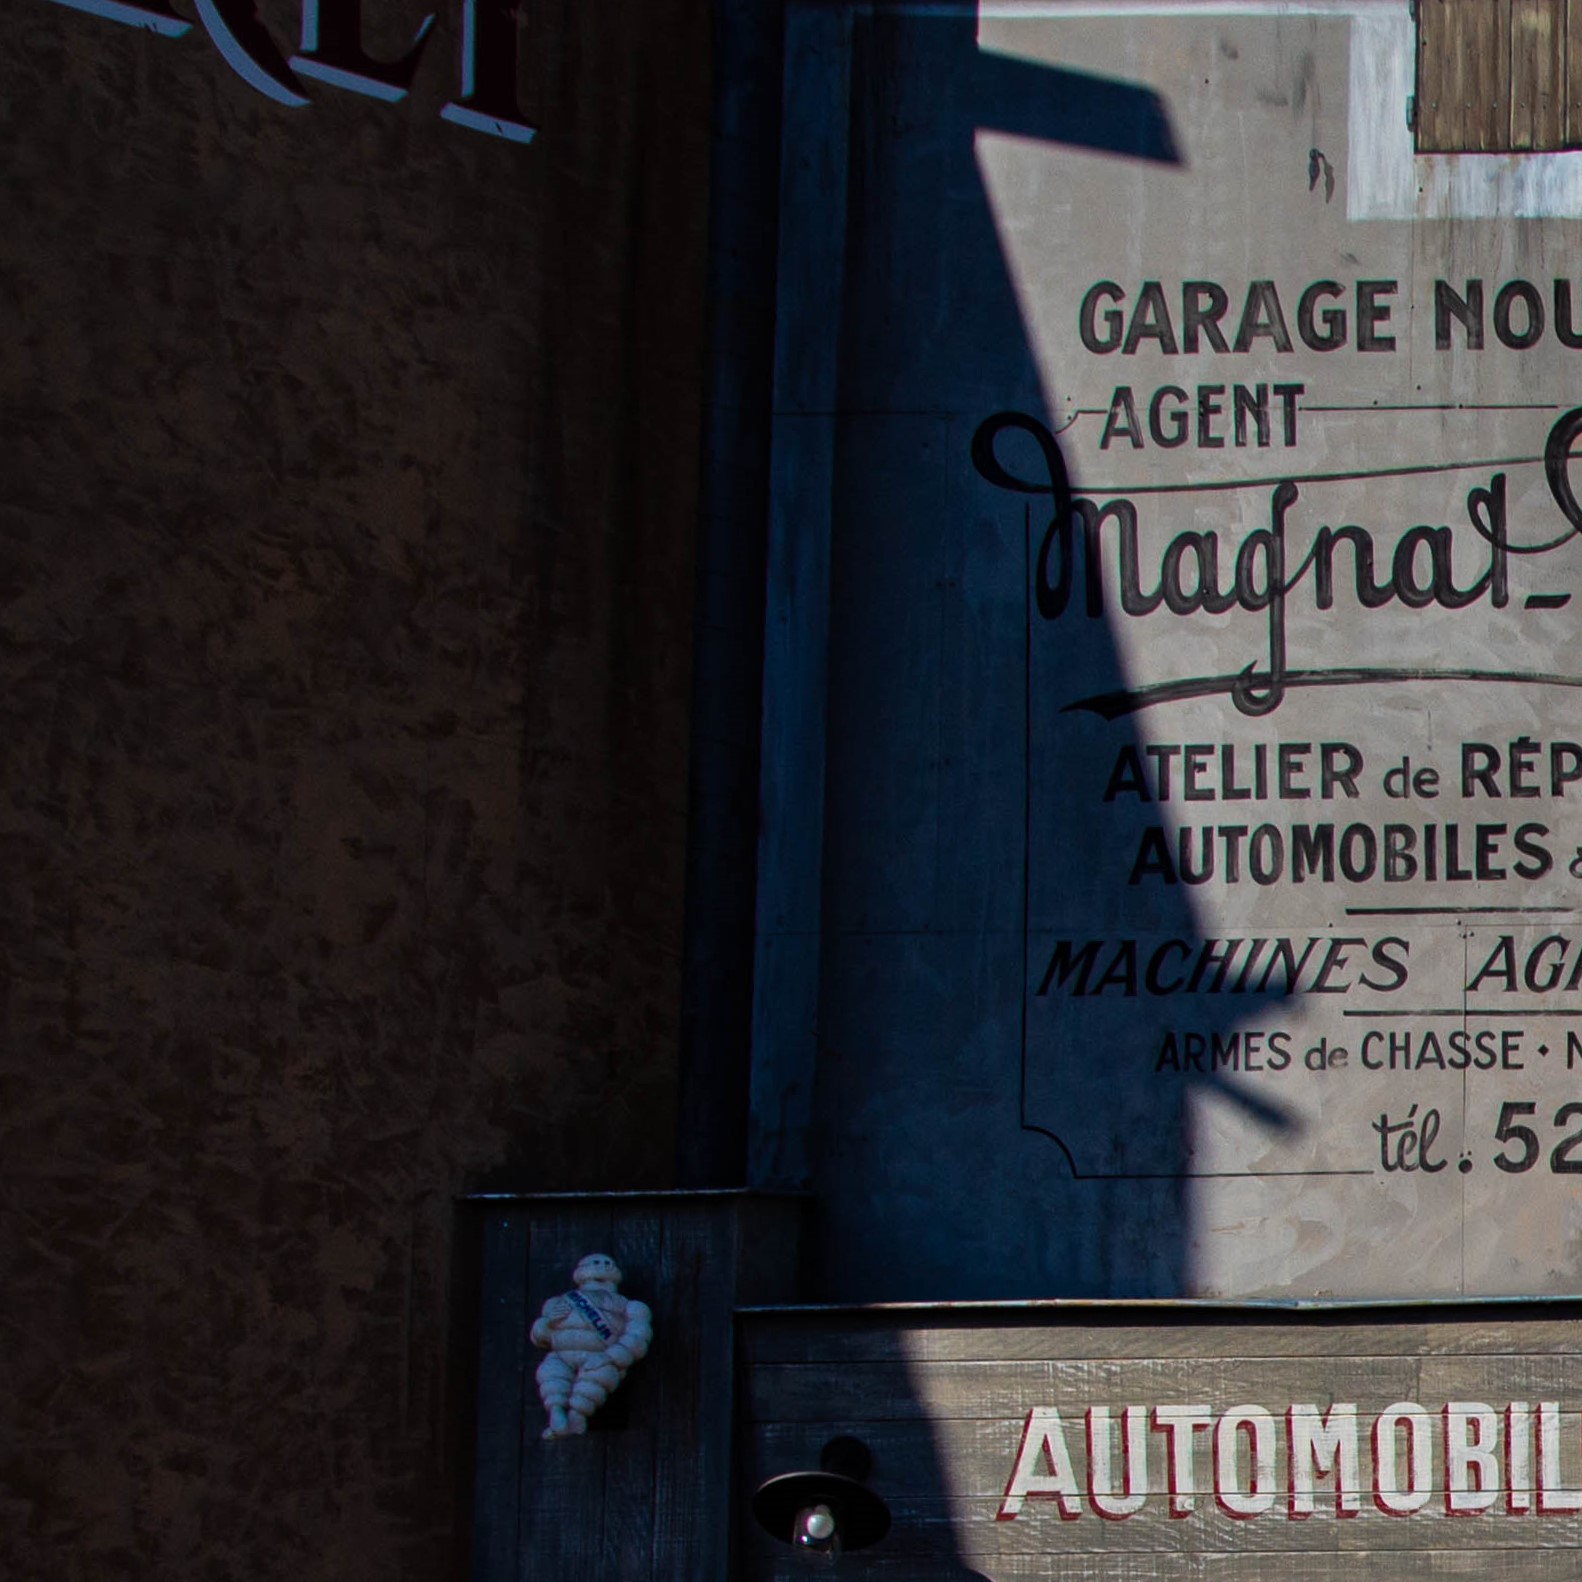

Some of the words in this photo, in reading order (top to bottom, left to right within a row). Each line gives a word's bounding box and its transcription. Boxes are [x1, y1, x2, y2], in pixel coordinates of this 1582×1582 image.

[1079, 277, 1399, 356] GARAGE
[1099, 383, 1305, 450] AGENT
[1103, 742, 1365, 804] ATELIER
[1382, 755, 1442, 802] de
[1129, 821, 1554, 888] AUTOMOBILES
[1034, 934, 1413, 1000] MACHINES
[1155, 1030, 1293, 1074] ARMES
[1303, 1034, 1350, 1072] de
[1360, 1030, 1525, 1073] CHASSE
